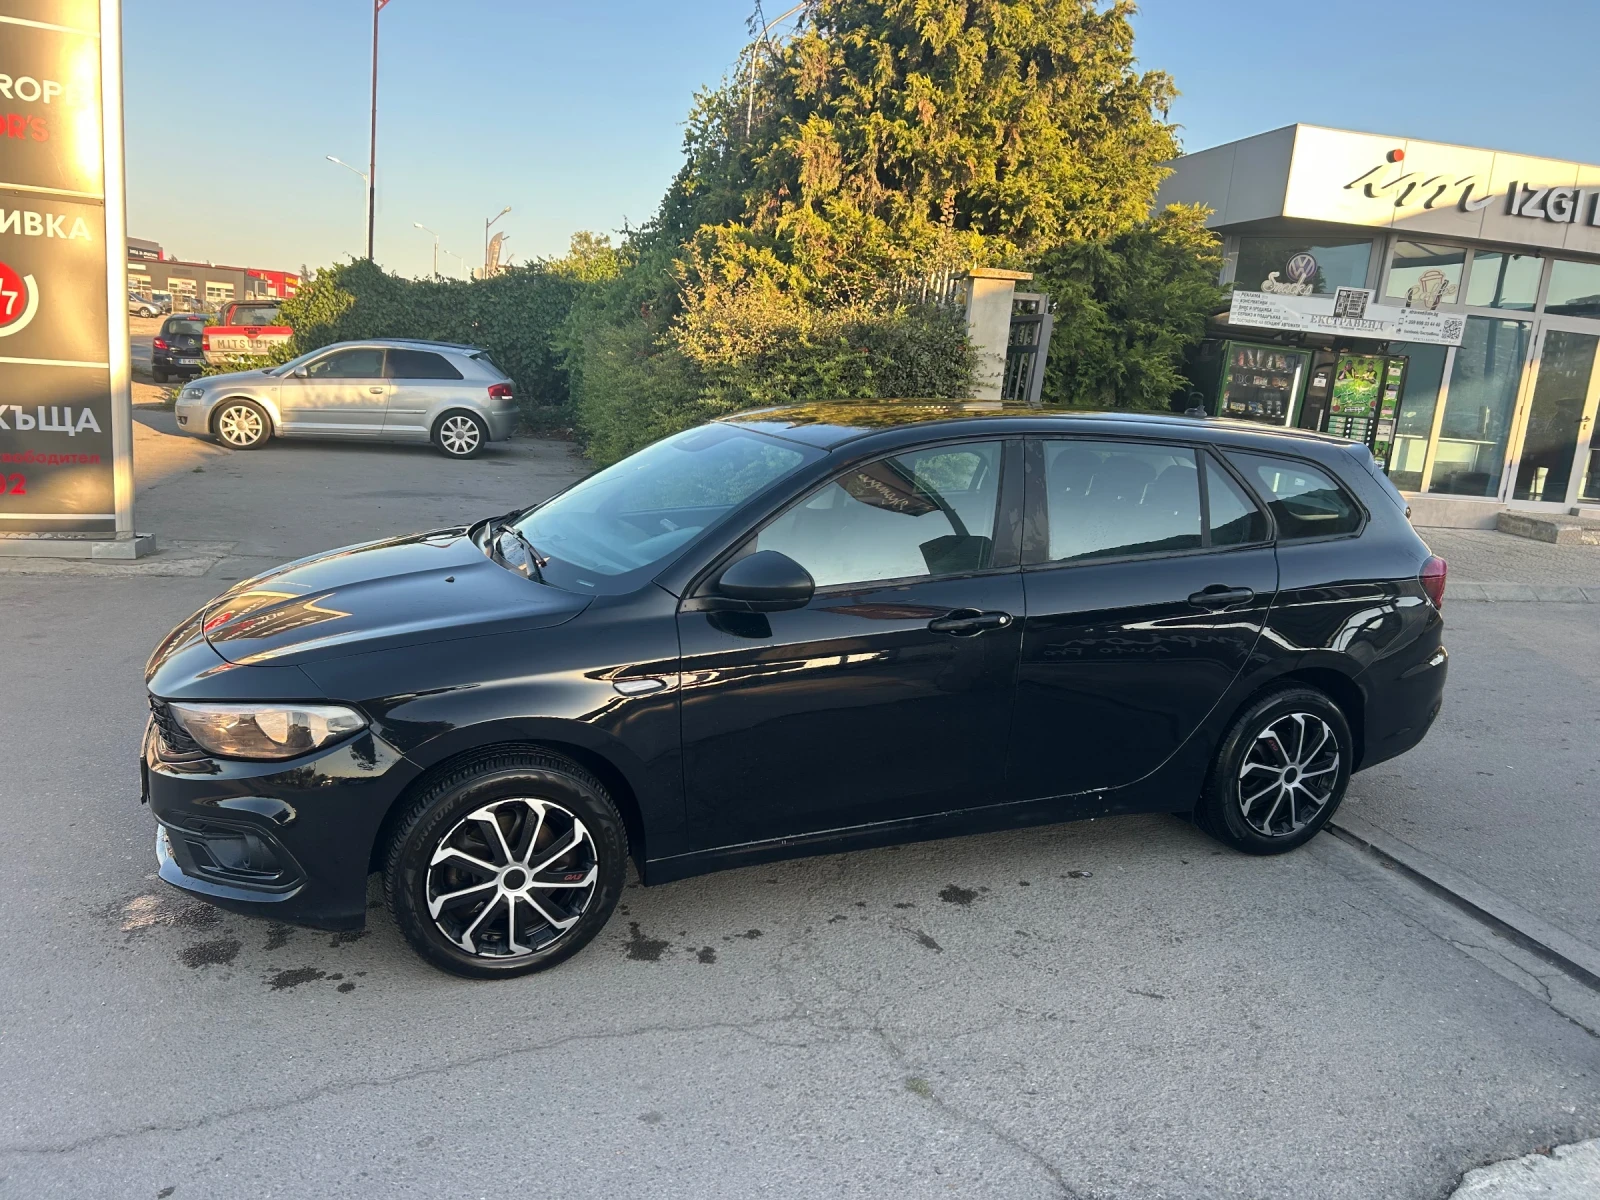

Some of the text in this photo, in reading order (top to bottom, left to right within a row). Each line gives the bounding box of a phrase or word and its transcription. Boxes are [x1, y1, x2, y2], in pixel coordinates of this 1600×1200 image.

[0, 208, 93, 241] ИВКА
[1260, 271, 1313, 296] Snacks
[0, 448, 101, 466] вободител
